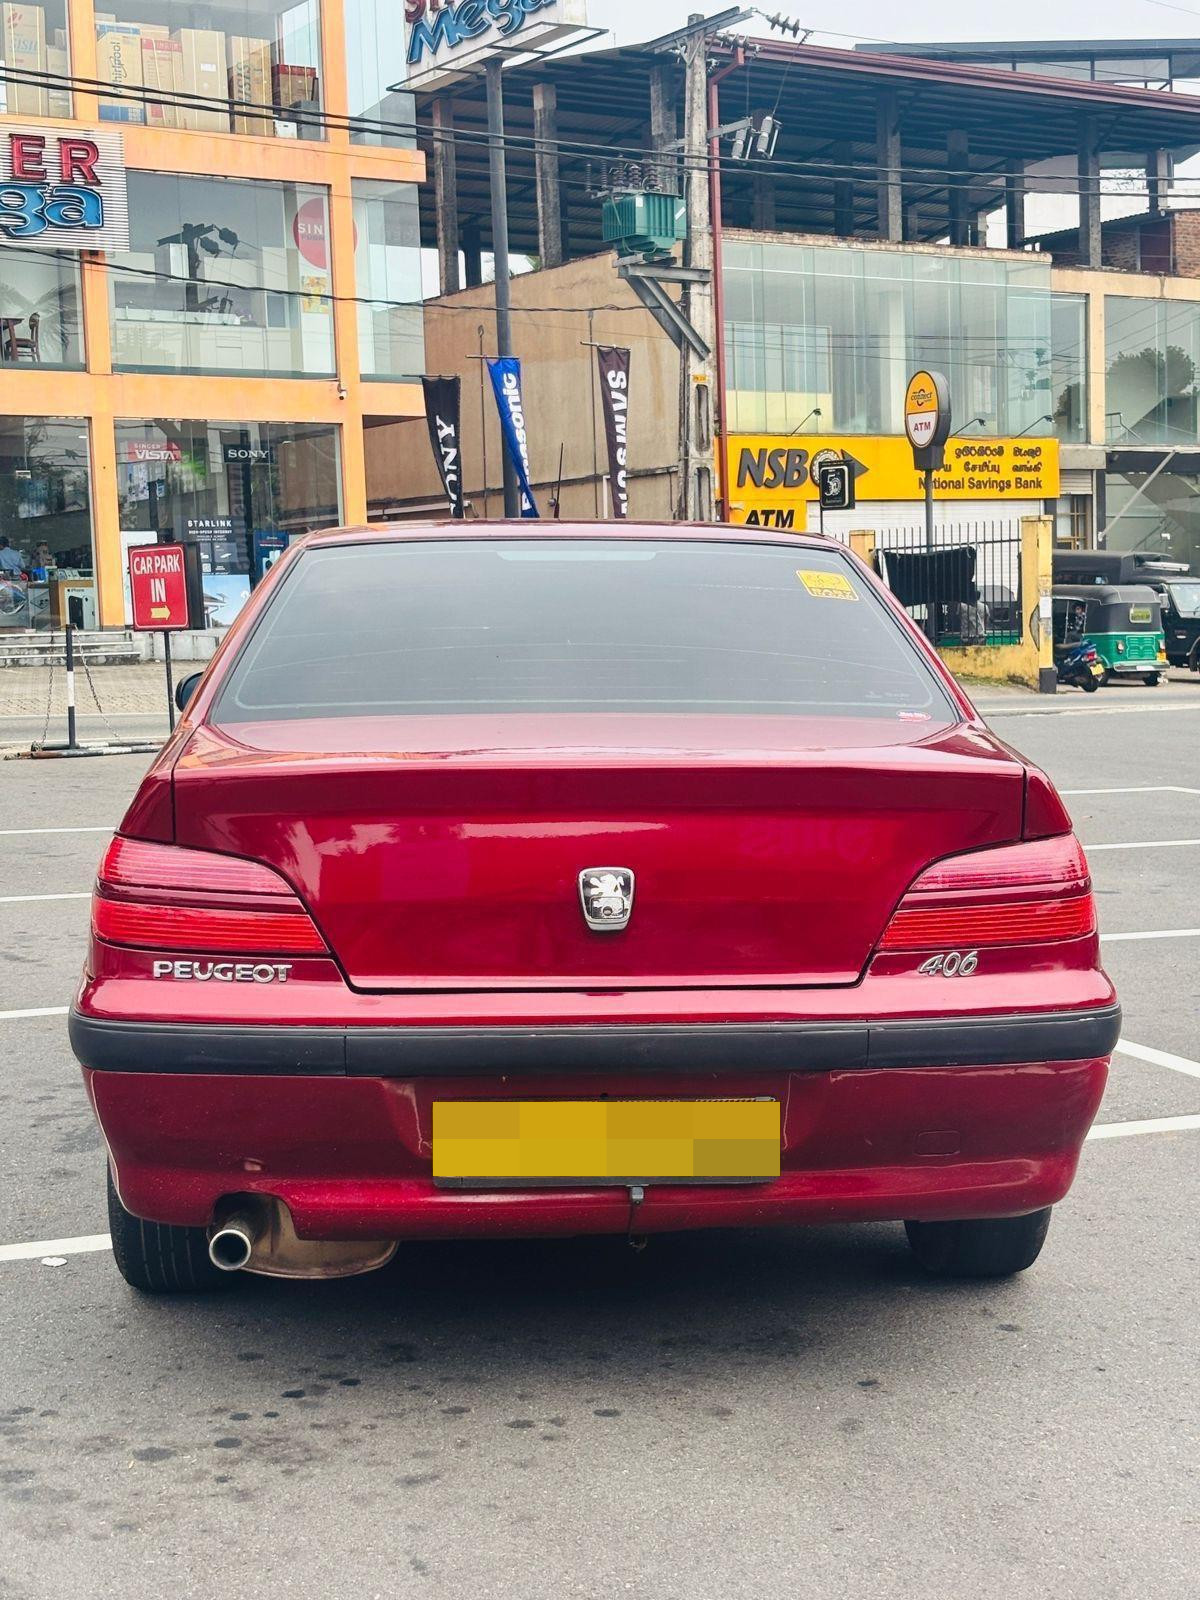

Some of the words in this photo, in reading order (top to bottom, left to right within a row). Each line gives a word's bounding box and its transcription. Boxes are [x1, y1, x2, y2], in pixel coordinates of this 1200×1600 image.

[298, 223, 323, 235] SIN
[913, 421, 931, 432] ATM
[135, 450, 175, 460] VISTA
[228, 450, 269, 459] SONY
[737, 448, 810, 488] NSB
[918, 477, 965, 489] Ntional
[967, 477, 1012, 492] Savings
[1014, 477, 1043, 489] Bank
[745, 509, 795, 528] ATM
[133, 557, 153, 575] CAR
[154, 554, 181, 573] PARK
[150, 578, 167, 602] IN
[153, 960, 293, 983] PEUGEOT
[918, 950, 979, 978] 406
